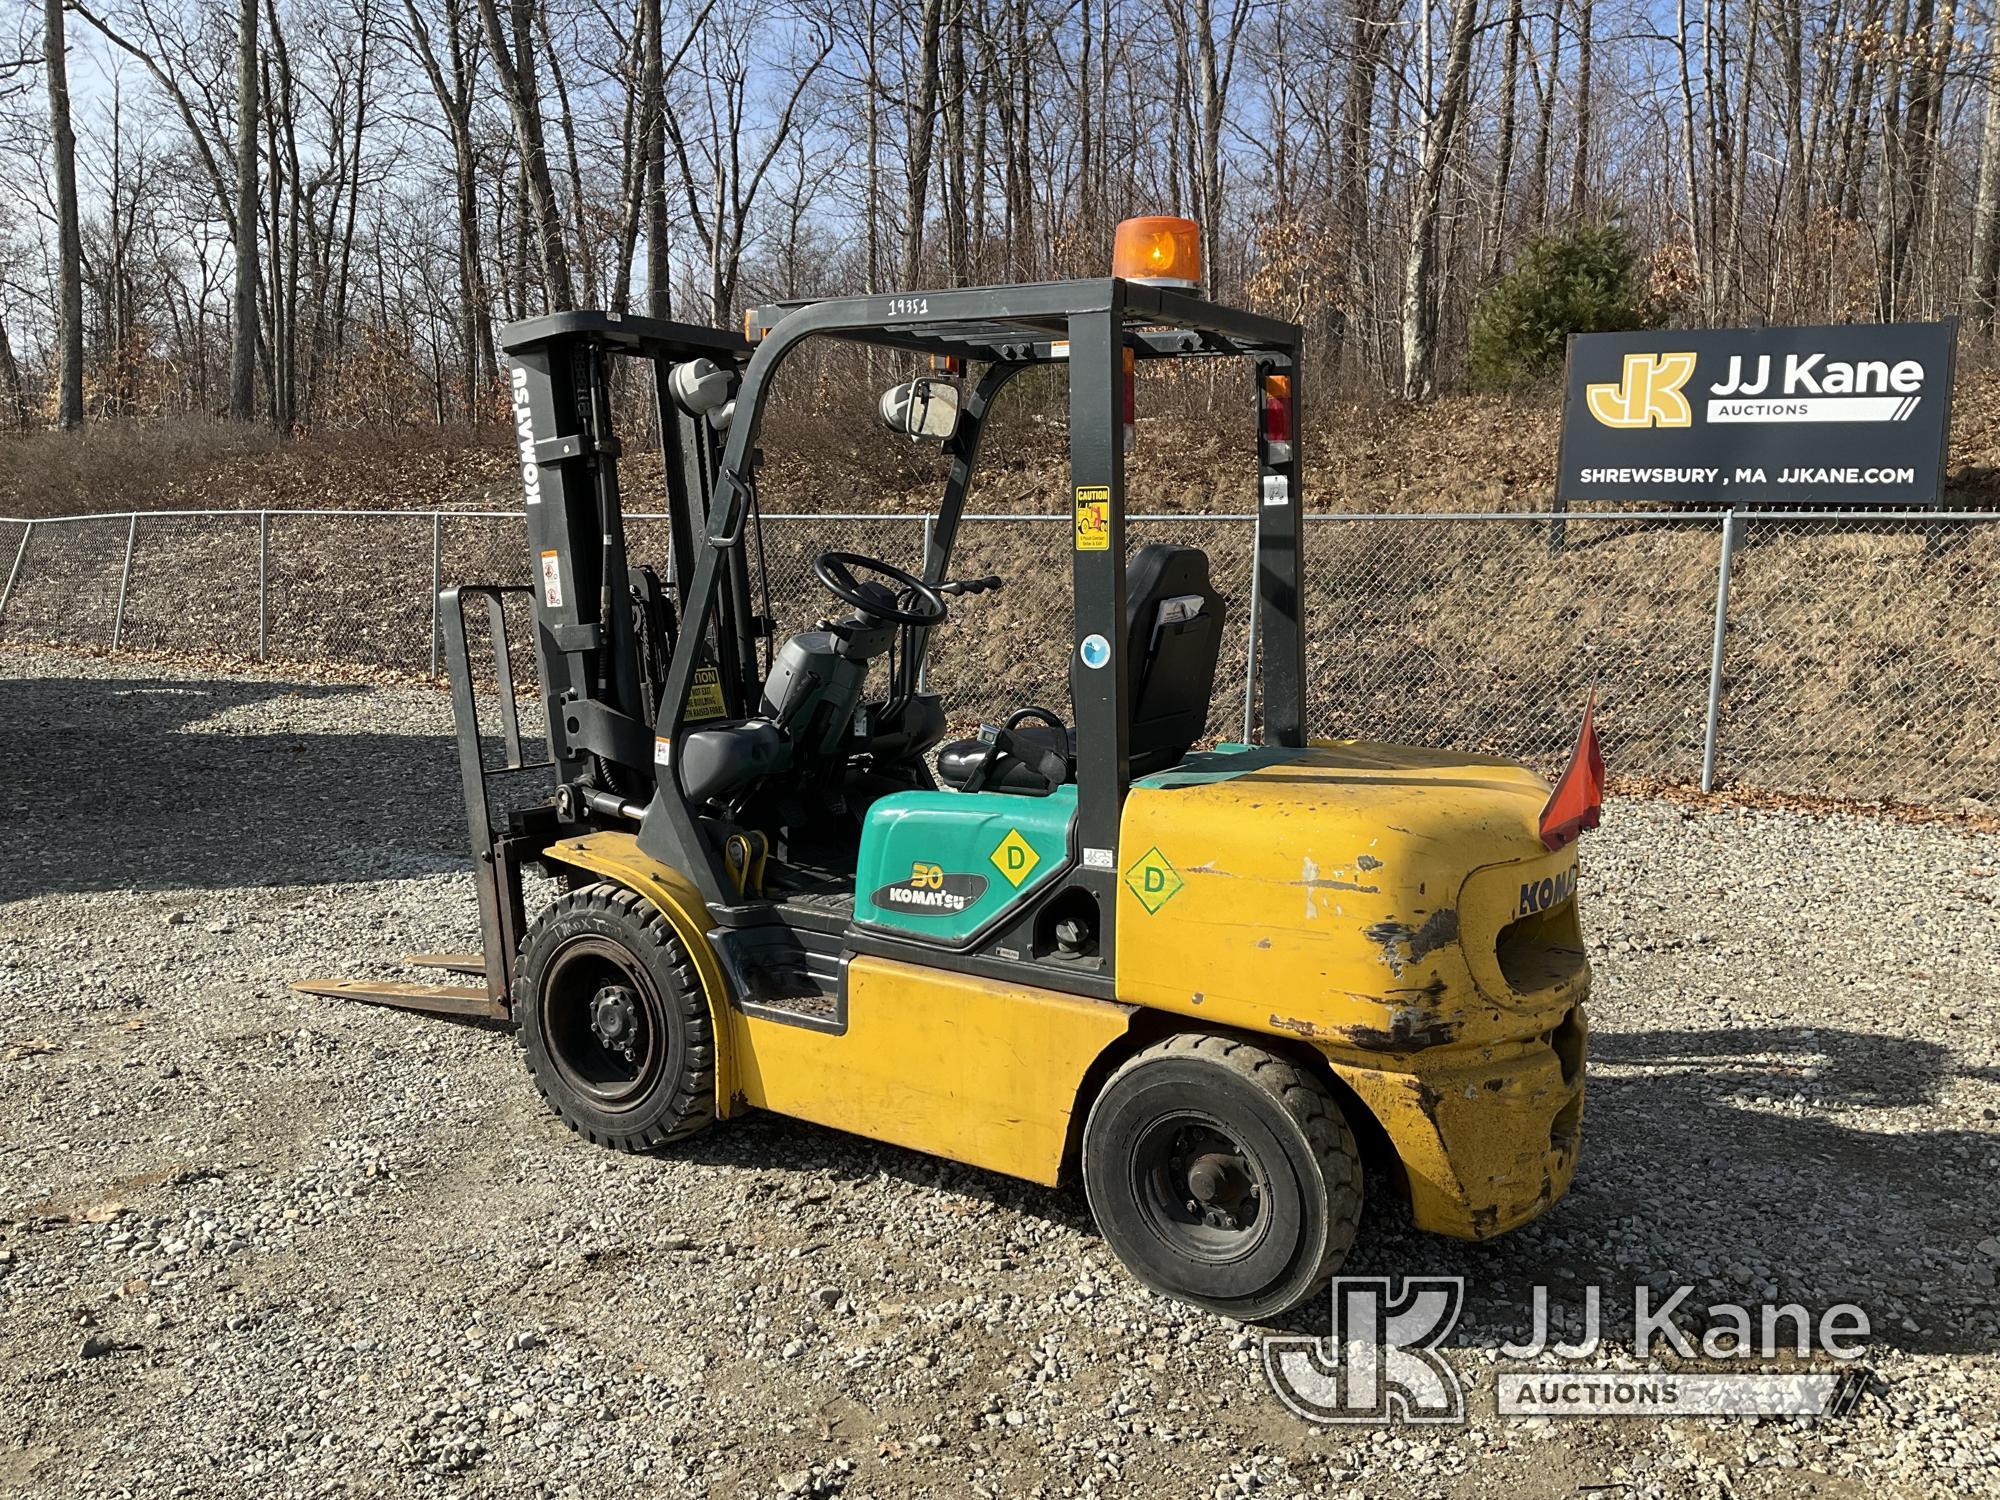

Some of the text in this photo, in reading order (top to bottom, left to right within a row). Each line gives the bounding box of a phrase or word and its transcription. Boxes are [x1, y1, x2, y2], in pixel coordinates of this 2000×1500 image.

[887, 298, 929, 316] 19351
[1709, 352, 1925, 396] JJ Kane
[1718, 403, 1809, 417] AUCTIONS
[511, 367, 542, 506] KOMATSU
[1579, 467, 1719, 484] SHREWSBURY
[1735, 468, 1767, 484] MA
[1777, 467, 1915, 484] JJKANE.COM
[1078, 490, 1108, 501] CAUTION
[694, 671, 716, 684] TION
[1007, 845, 1026, 870] D
[911, 862, 944, 890] 30
[1144, 866, 1165, 893] D
[889, 887, 965, 910] KOMATSU
[1519, 863, 1578, 915] KOMA
